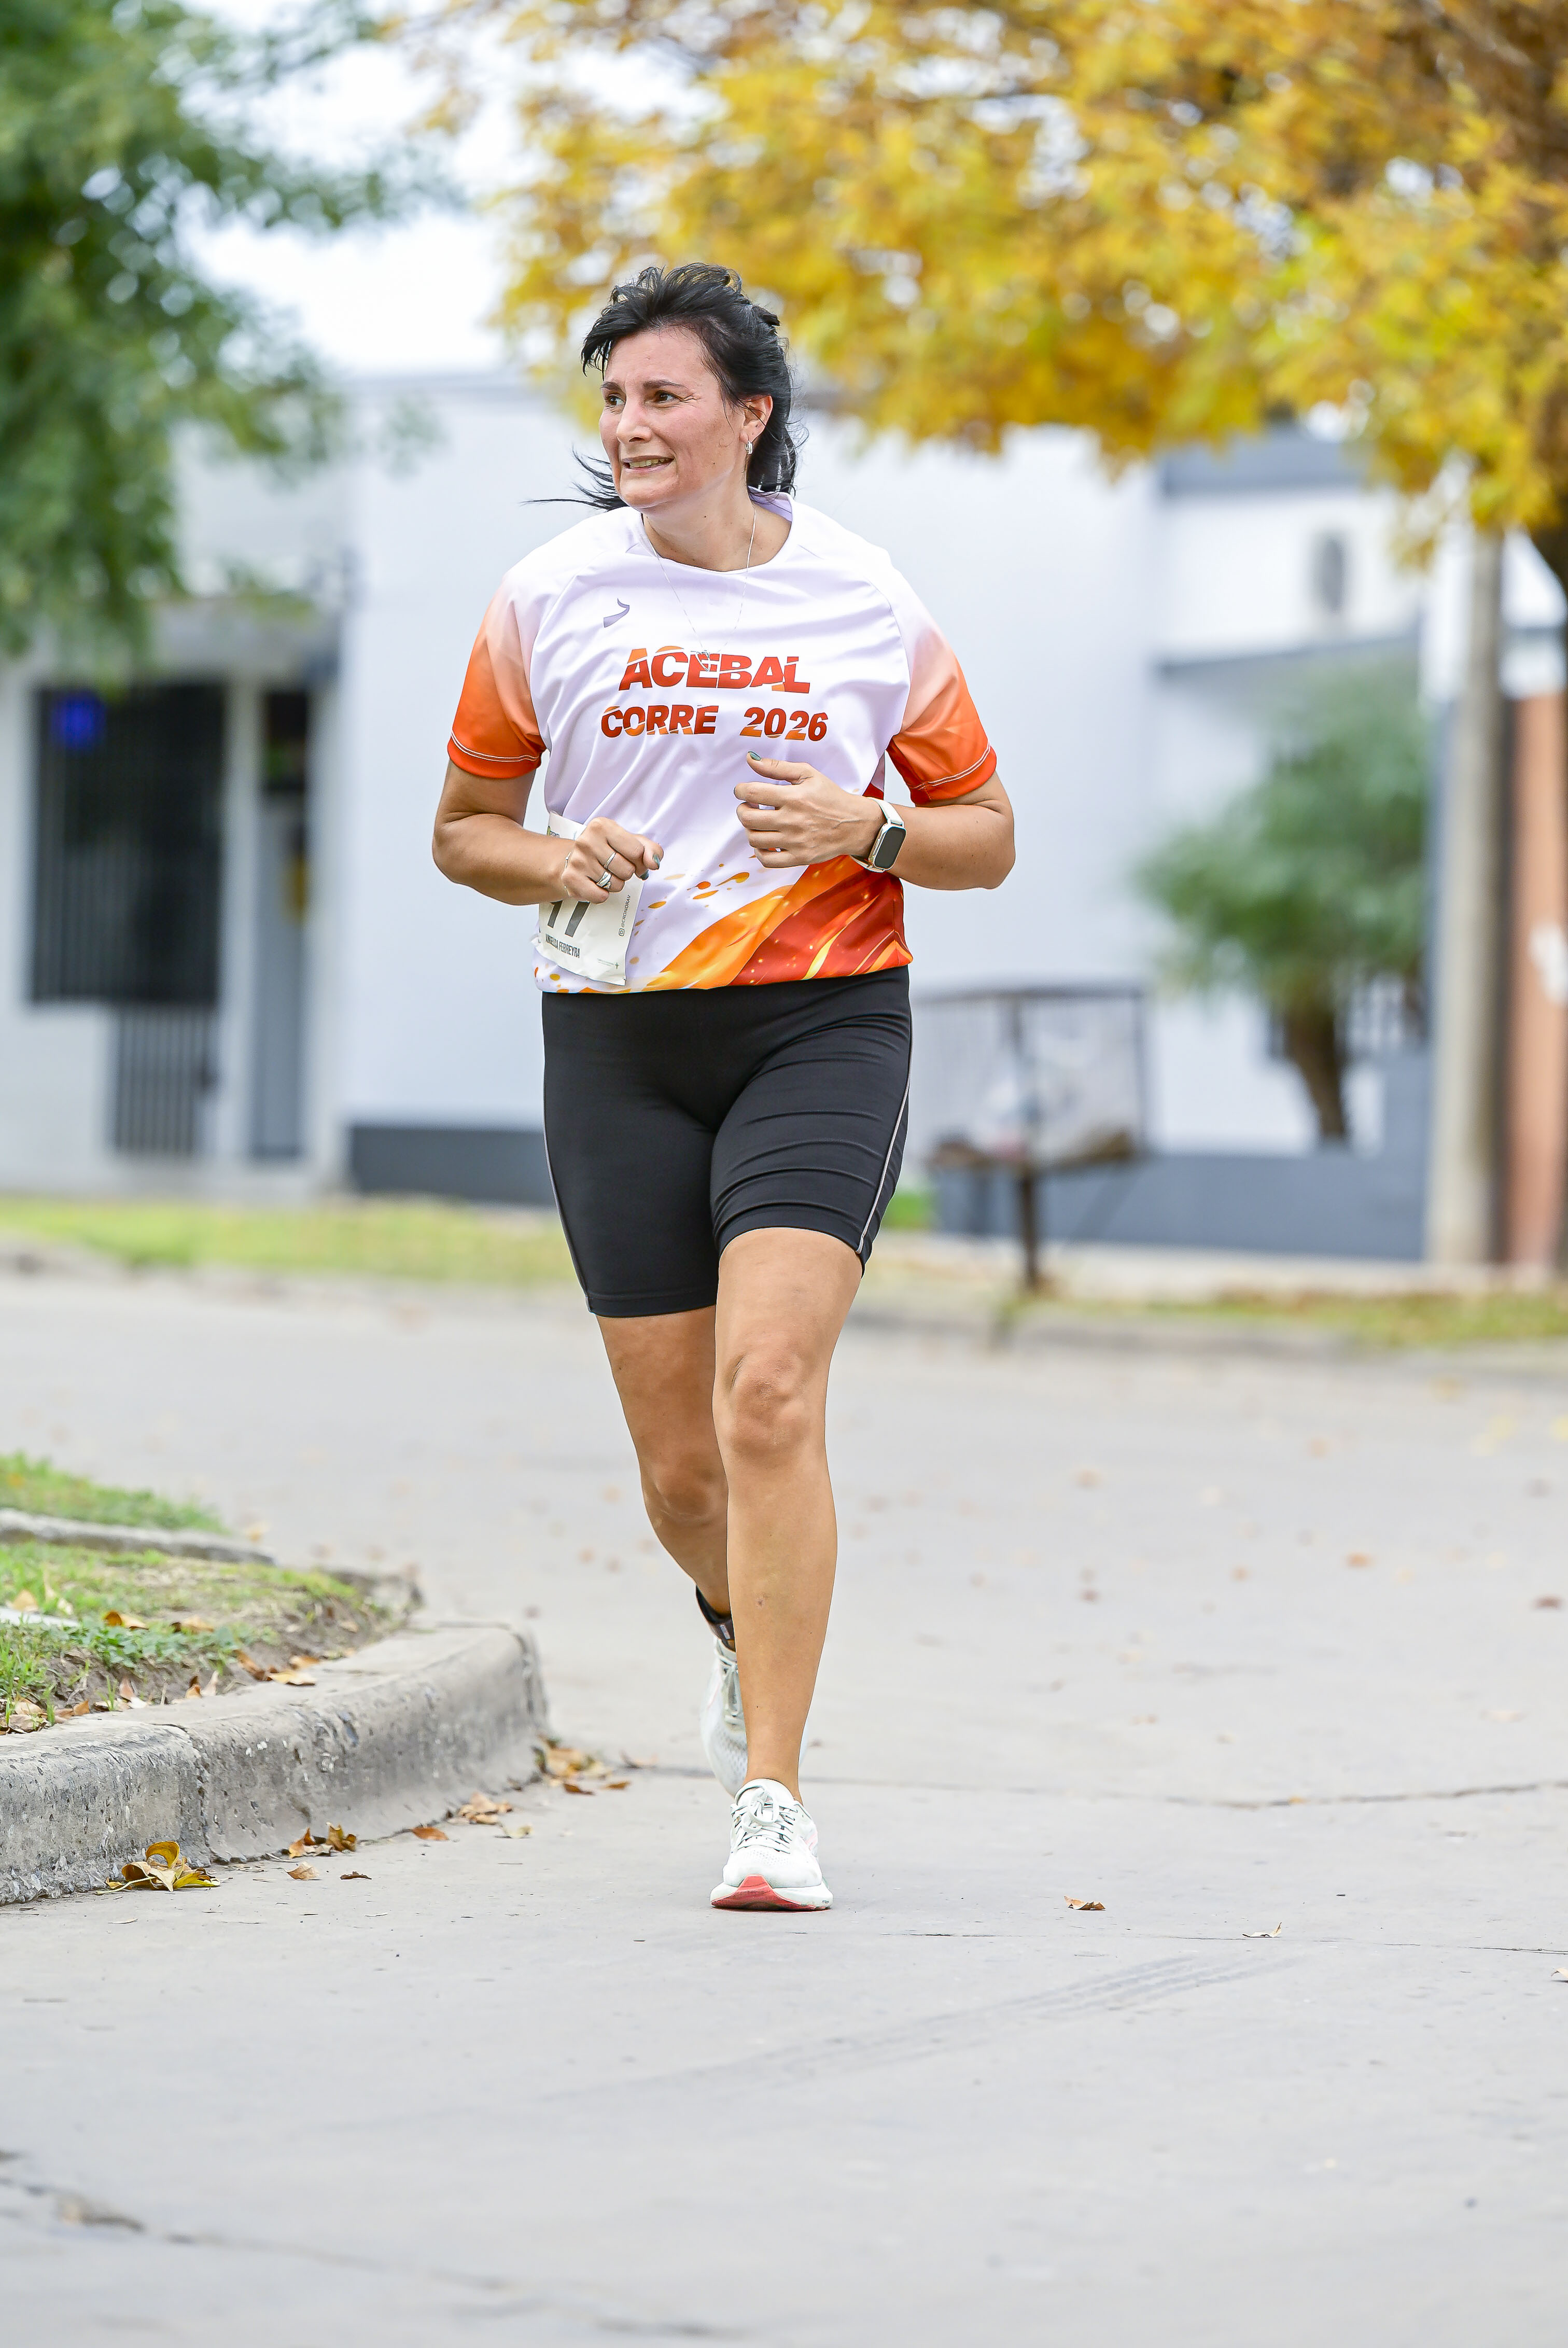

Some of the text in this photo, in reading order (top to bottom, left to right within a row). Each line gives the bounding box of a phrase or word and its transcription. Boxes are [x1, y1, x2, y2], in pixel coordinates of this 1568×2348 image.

[618, 646, 810, 694] ACEBAL
[601, 705, 829, 742] CORRE 2026
